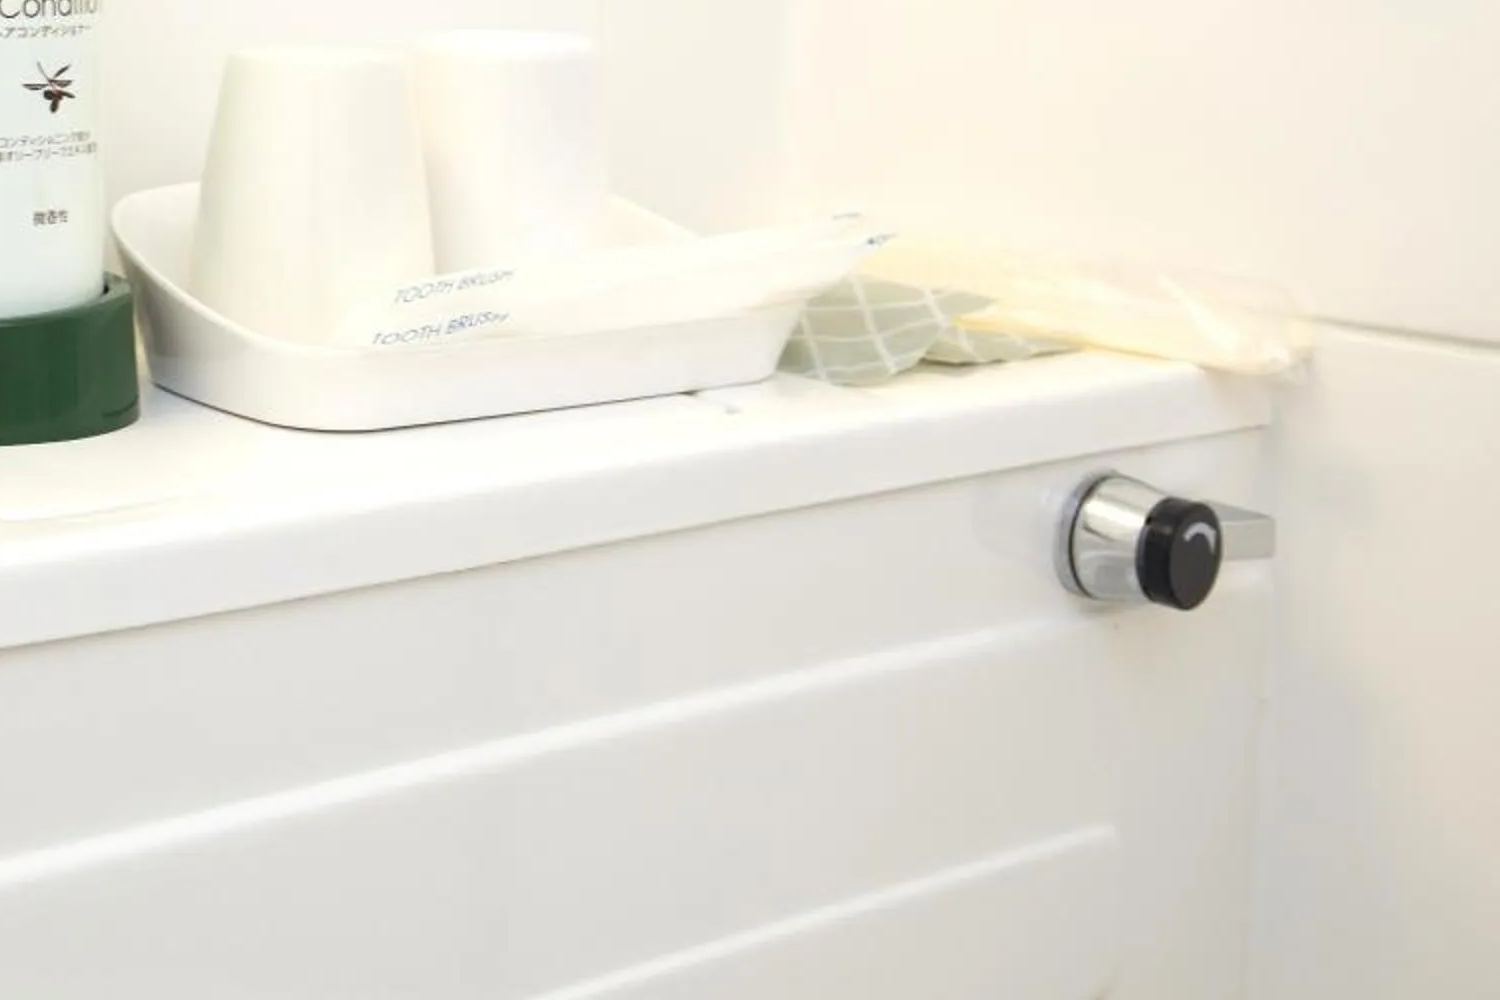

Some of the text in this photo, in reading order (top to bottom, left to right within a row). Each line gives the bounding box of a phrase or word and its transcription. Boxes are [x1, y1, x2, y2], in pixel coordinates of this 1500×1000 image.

[33, 209, 69, 226] 微香性
[393, 269, 516, 304] TOOTH BRUSH
[372, 323, 442, 346] TOOTH
